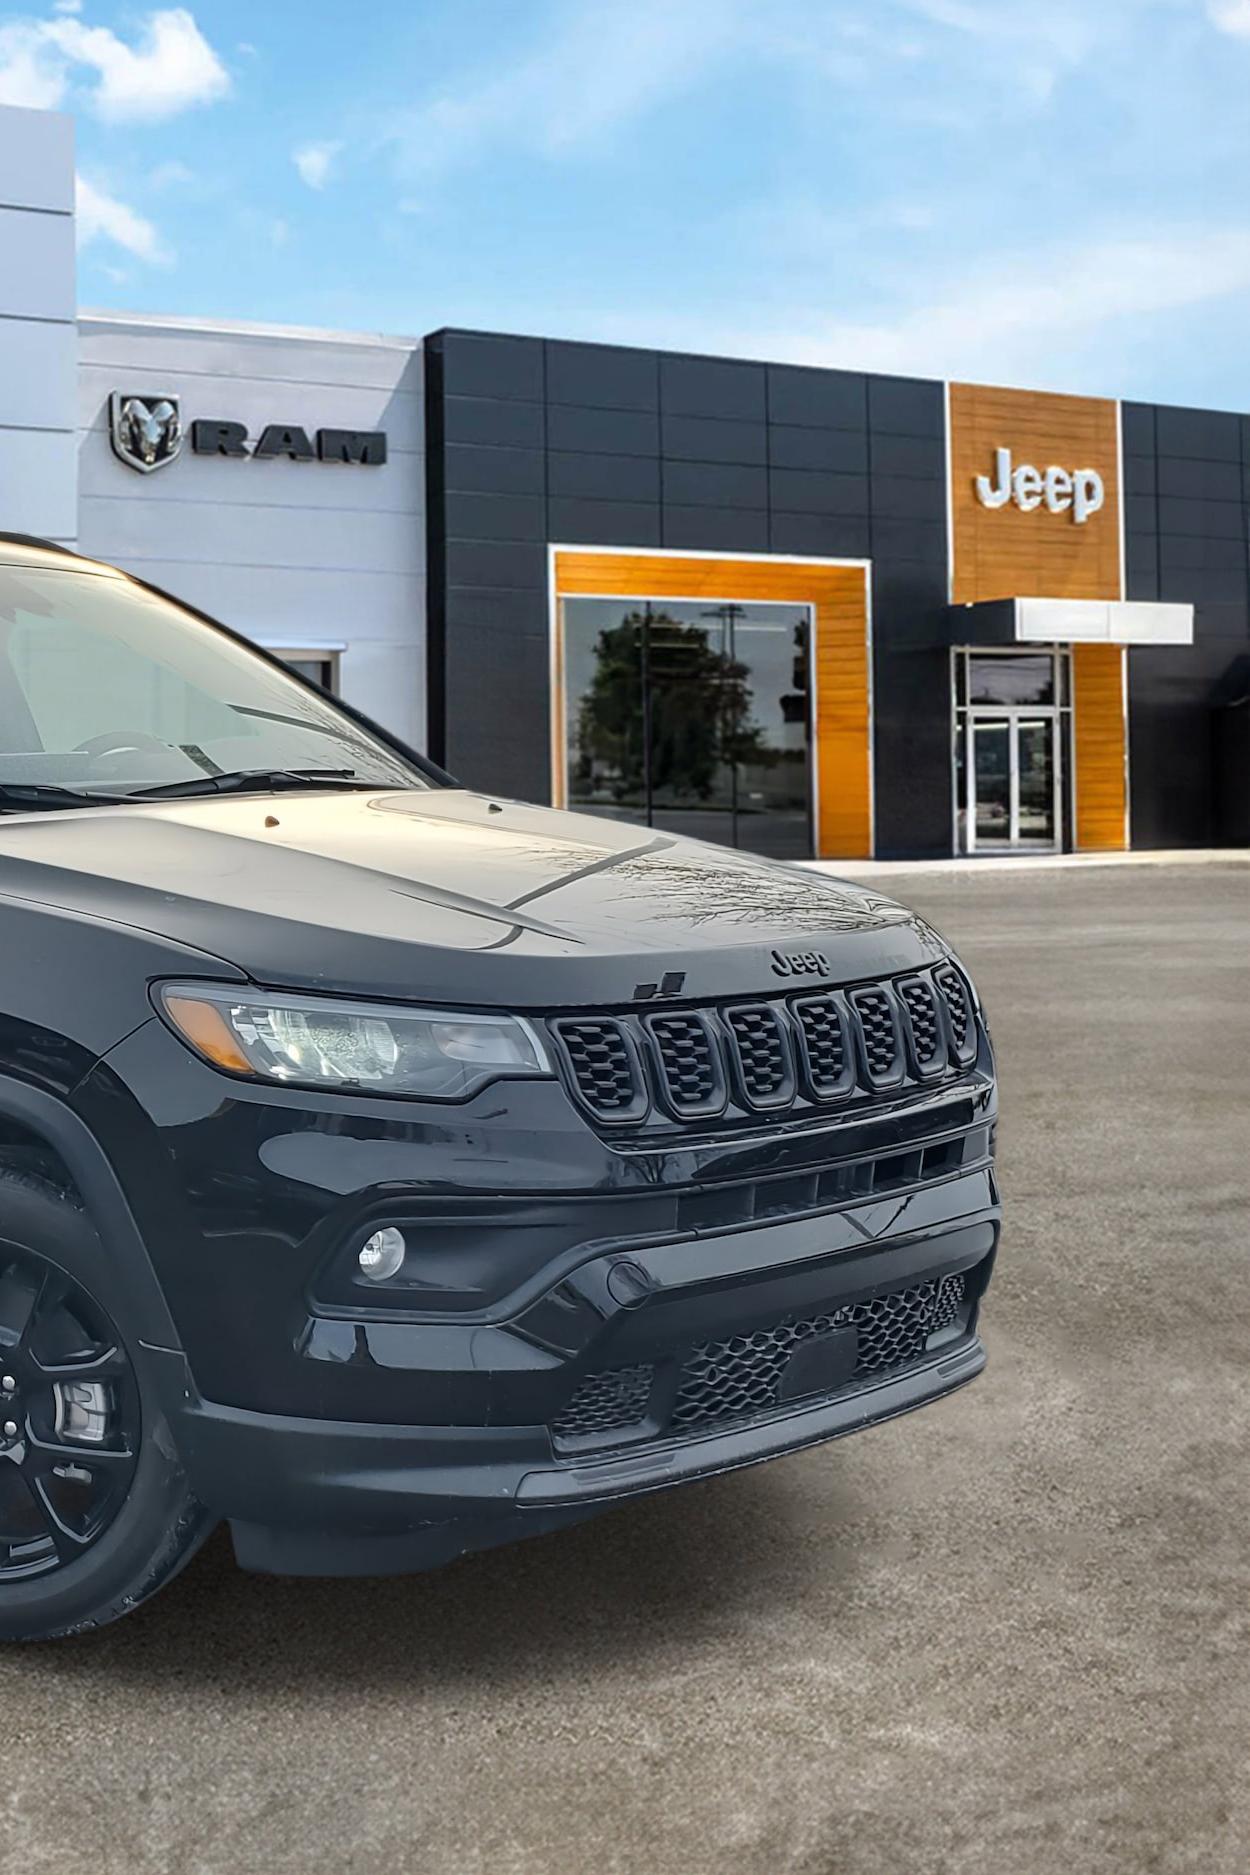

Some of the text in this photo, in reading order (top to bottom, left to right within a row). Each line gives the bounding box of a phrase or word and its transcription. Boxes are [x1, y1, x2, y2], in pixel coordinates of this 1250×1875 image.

[191, 418, 387, 465] RAM
[975, 447, 1104, 524] Jeep
[770, 950, 831, 977] Jeep
